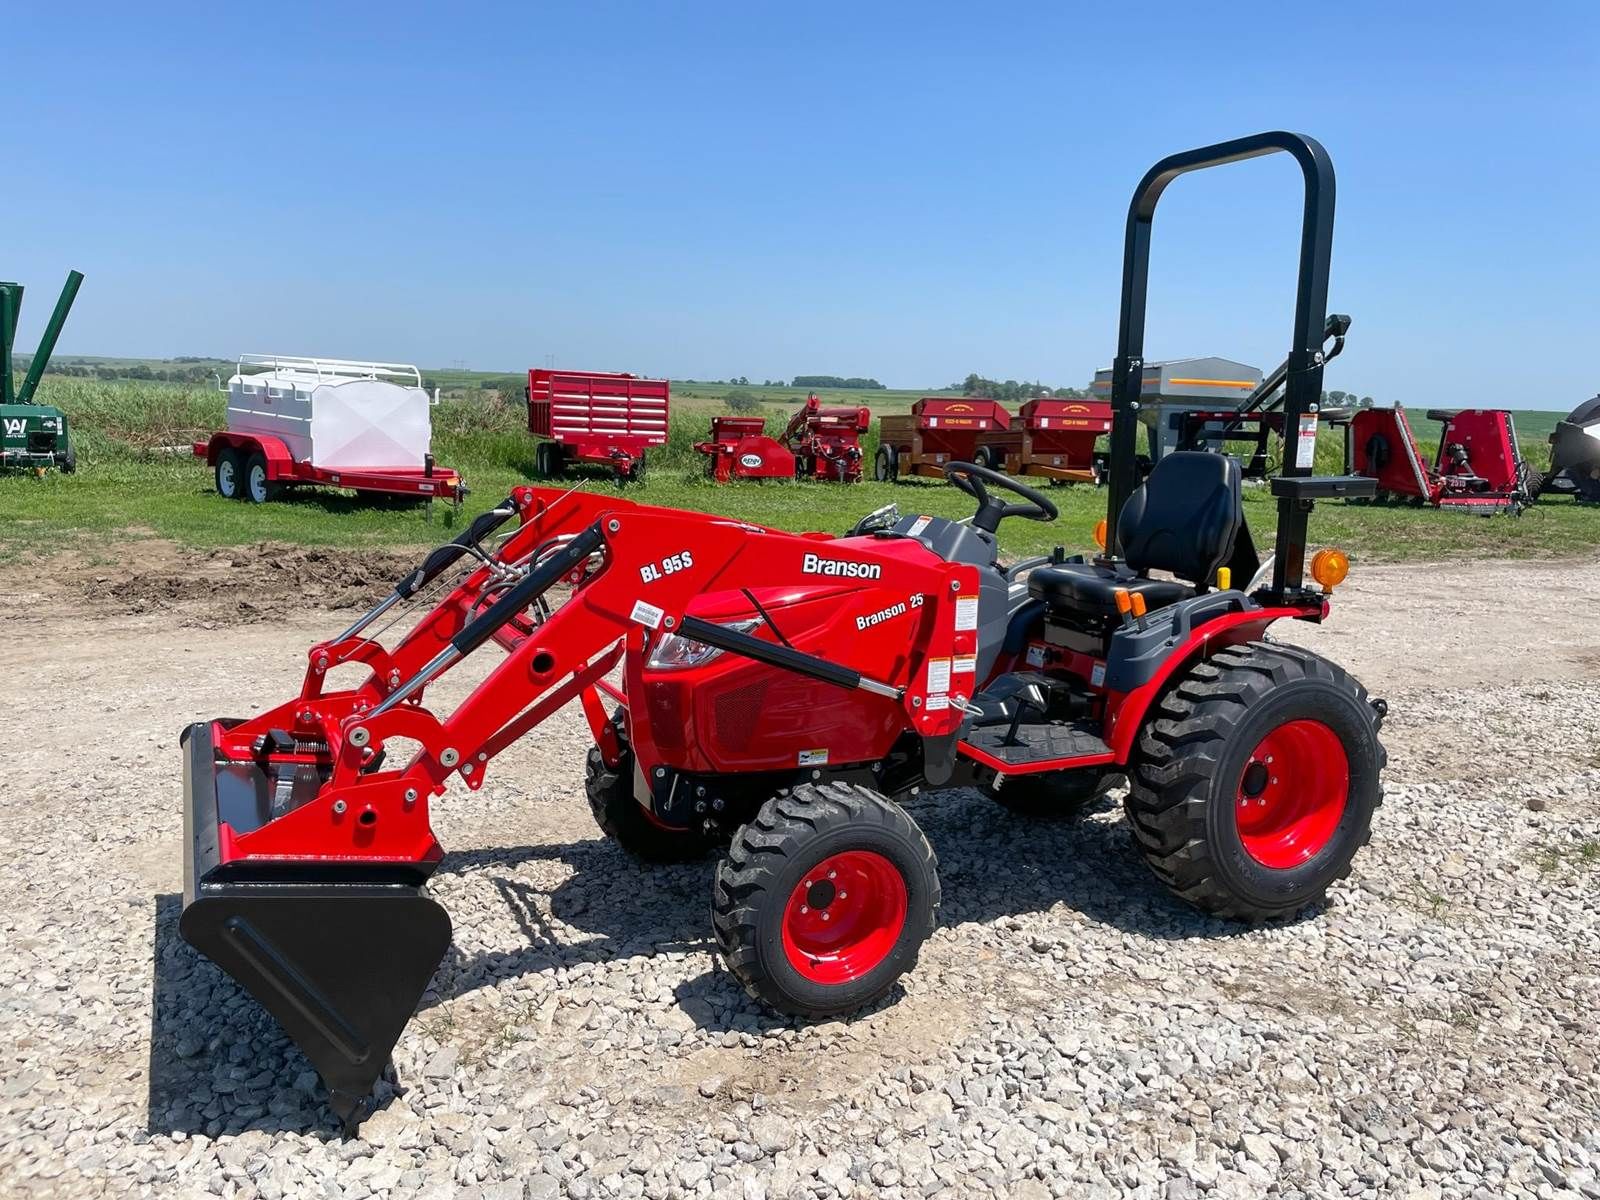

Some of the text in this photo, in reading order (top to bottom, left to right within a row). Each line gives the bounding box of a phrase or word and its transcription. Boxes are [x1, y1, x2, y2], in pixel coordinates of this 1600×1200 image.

[640, 551, 693, 584] BL 95S
[802, 553, 881, 579] Branson
[856, 592, 924, 630] Branson 25
